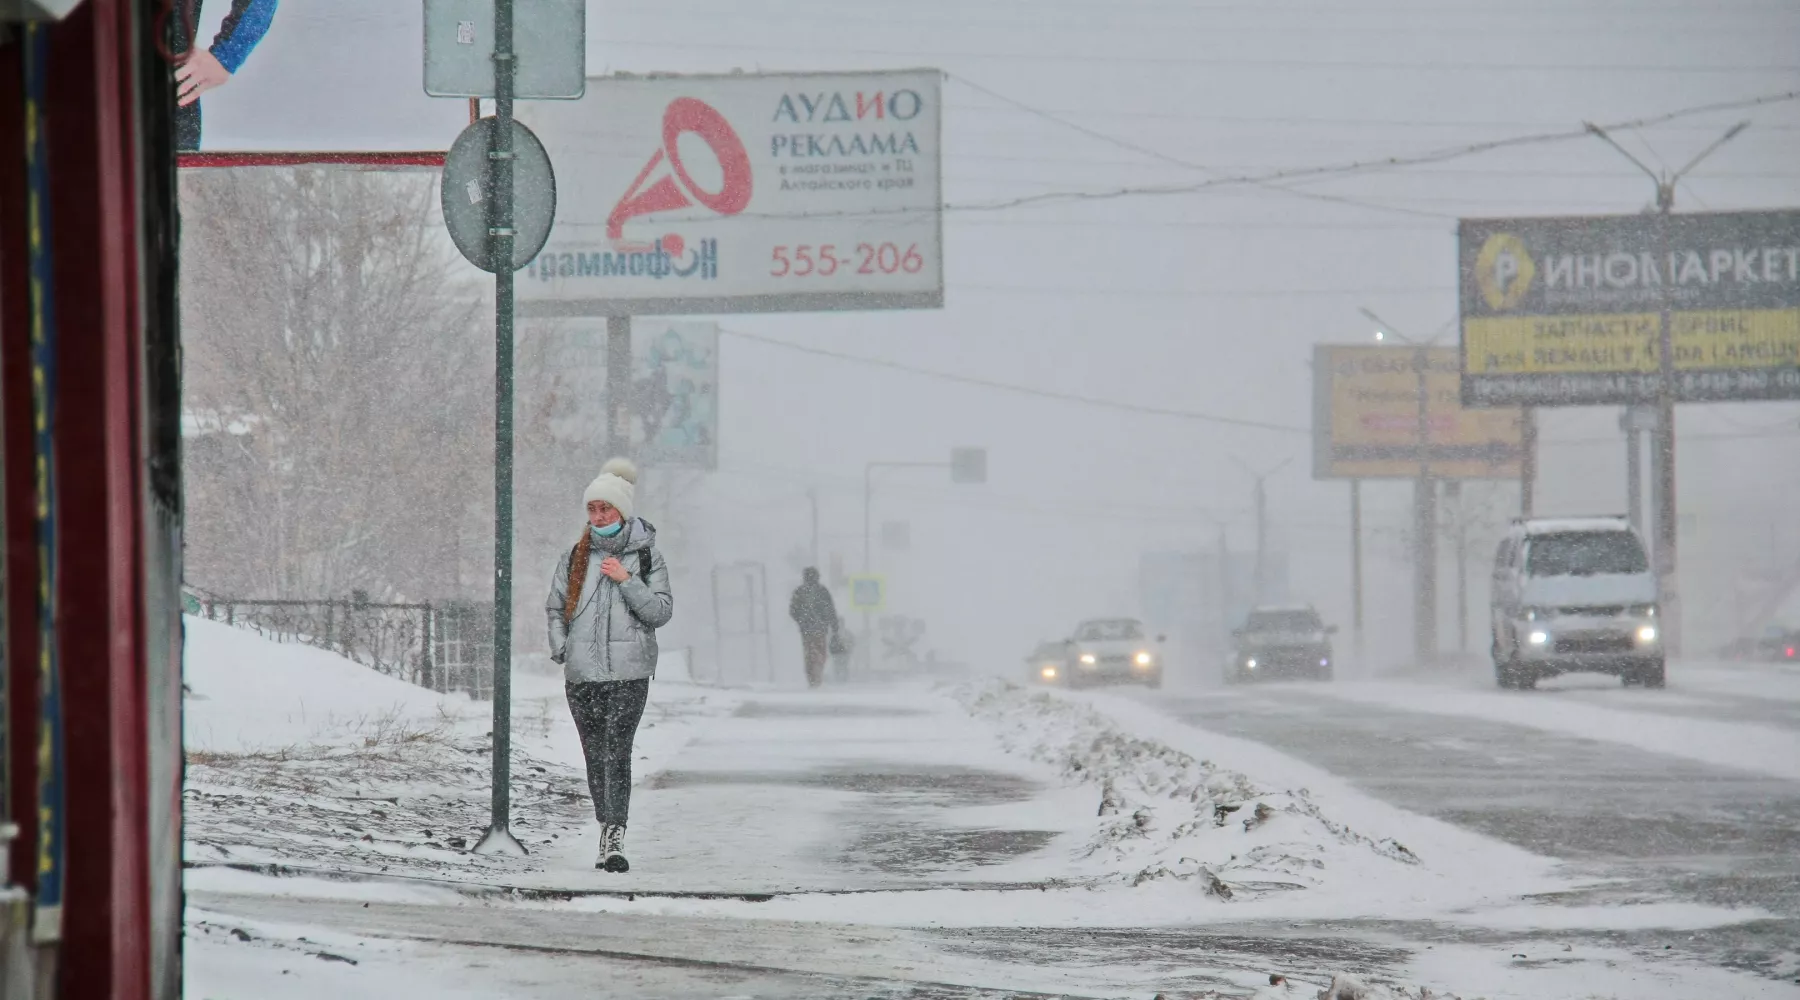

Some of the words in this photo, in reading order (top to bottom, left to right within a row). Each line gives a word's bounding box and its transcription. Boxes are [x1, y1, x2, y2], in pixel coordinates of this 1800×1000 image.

[773, 89, 923, 122] АУДИО
[771, 131, 921, 158] РЕКЛАМА
[780, 176, 872, 192] Алтайского
[877, 176, 915, 192] края
[770, 241, 924, 278] 555-206
